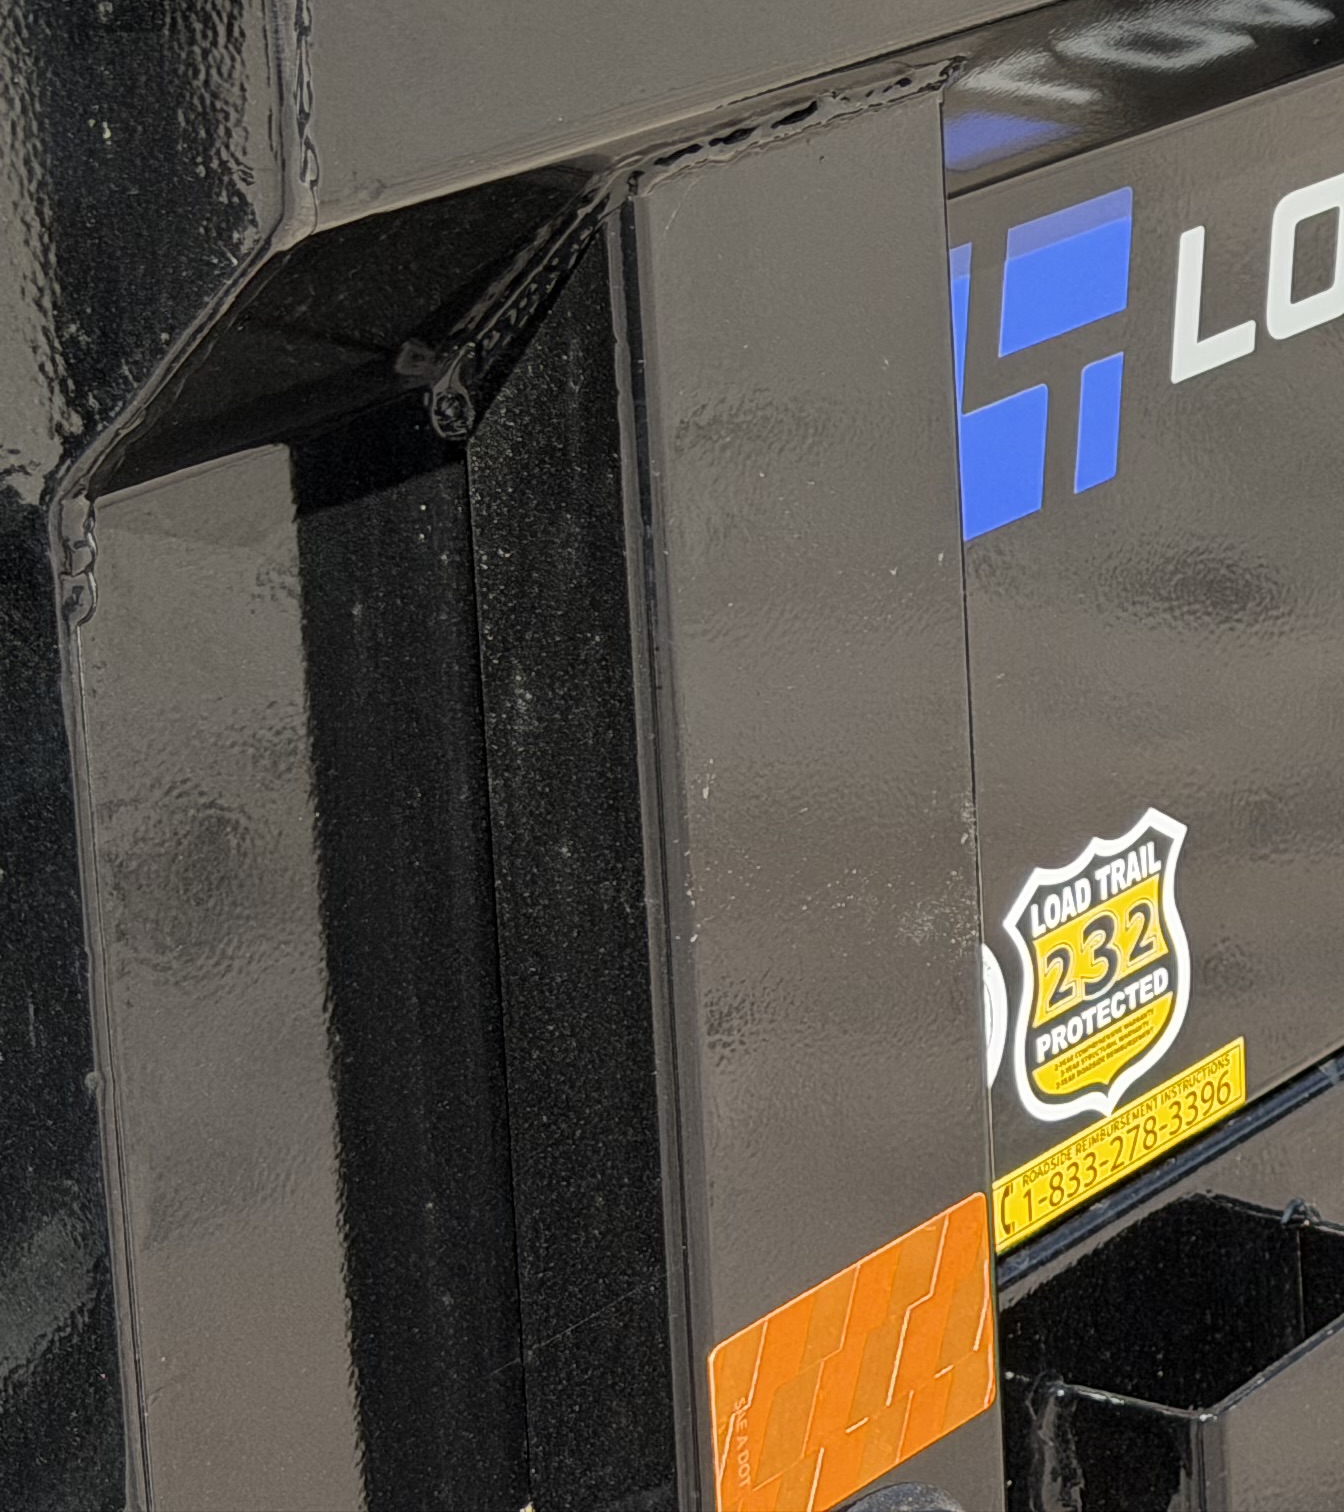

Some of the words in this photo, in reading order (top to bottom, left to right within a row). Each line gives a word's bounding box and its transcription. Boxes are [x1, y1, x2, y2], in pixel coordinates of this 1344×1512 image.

[1030, 876, 1091, 938] LOAD
[1094, 841, 1162, 903] TRAIL
[1036, 967, 1169, 1063] PROTECTED
[1044, 897, 1158, 1015] 232
[1022, 1146, 1073, 1188] ROADSIDE
[1075, 1096, 1159, 1157] REIMBURSEMENT
[1160, 1053, 1231, 1105] INSTRUCTIONS
[1022, 1070, 1232, 1222] 1-833-278-3396
